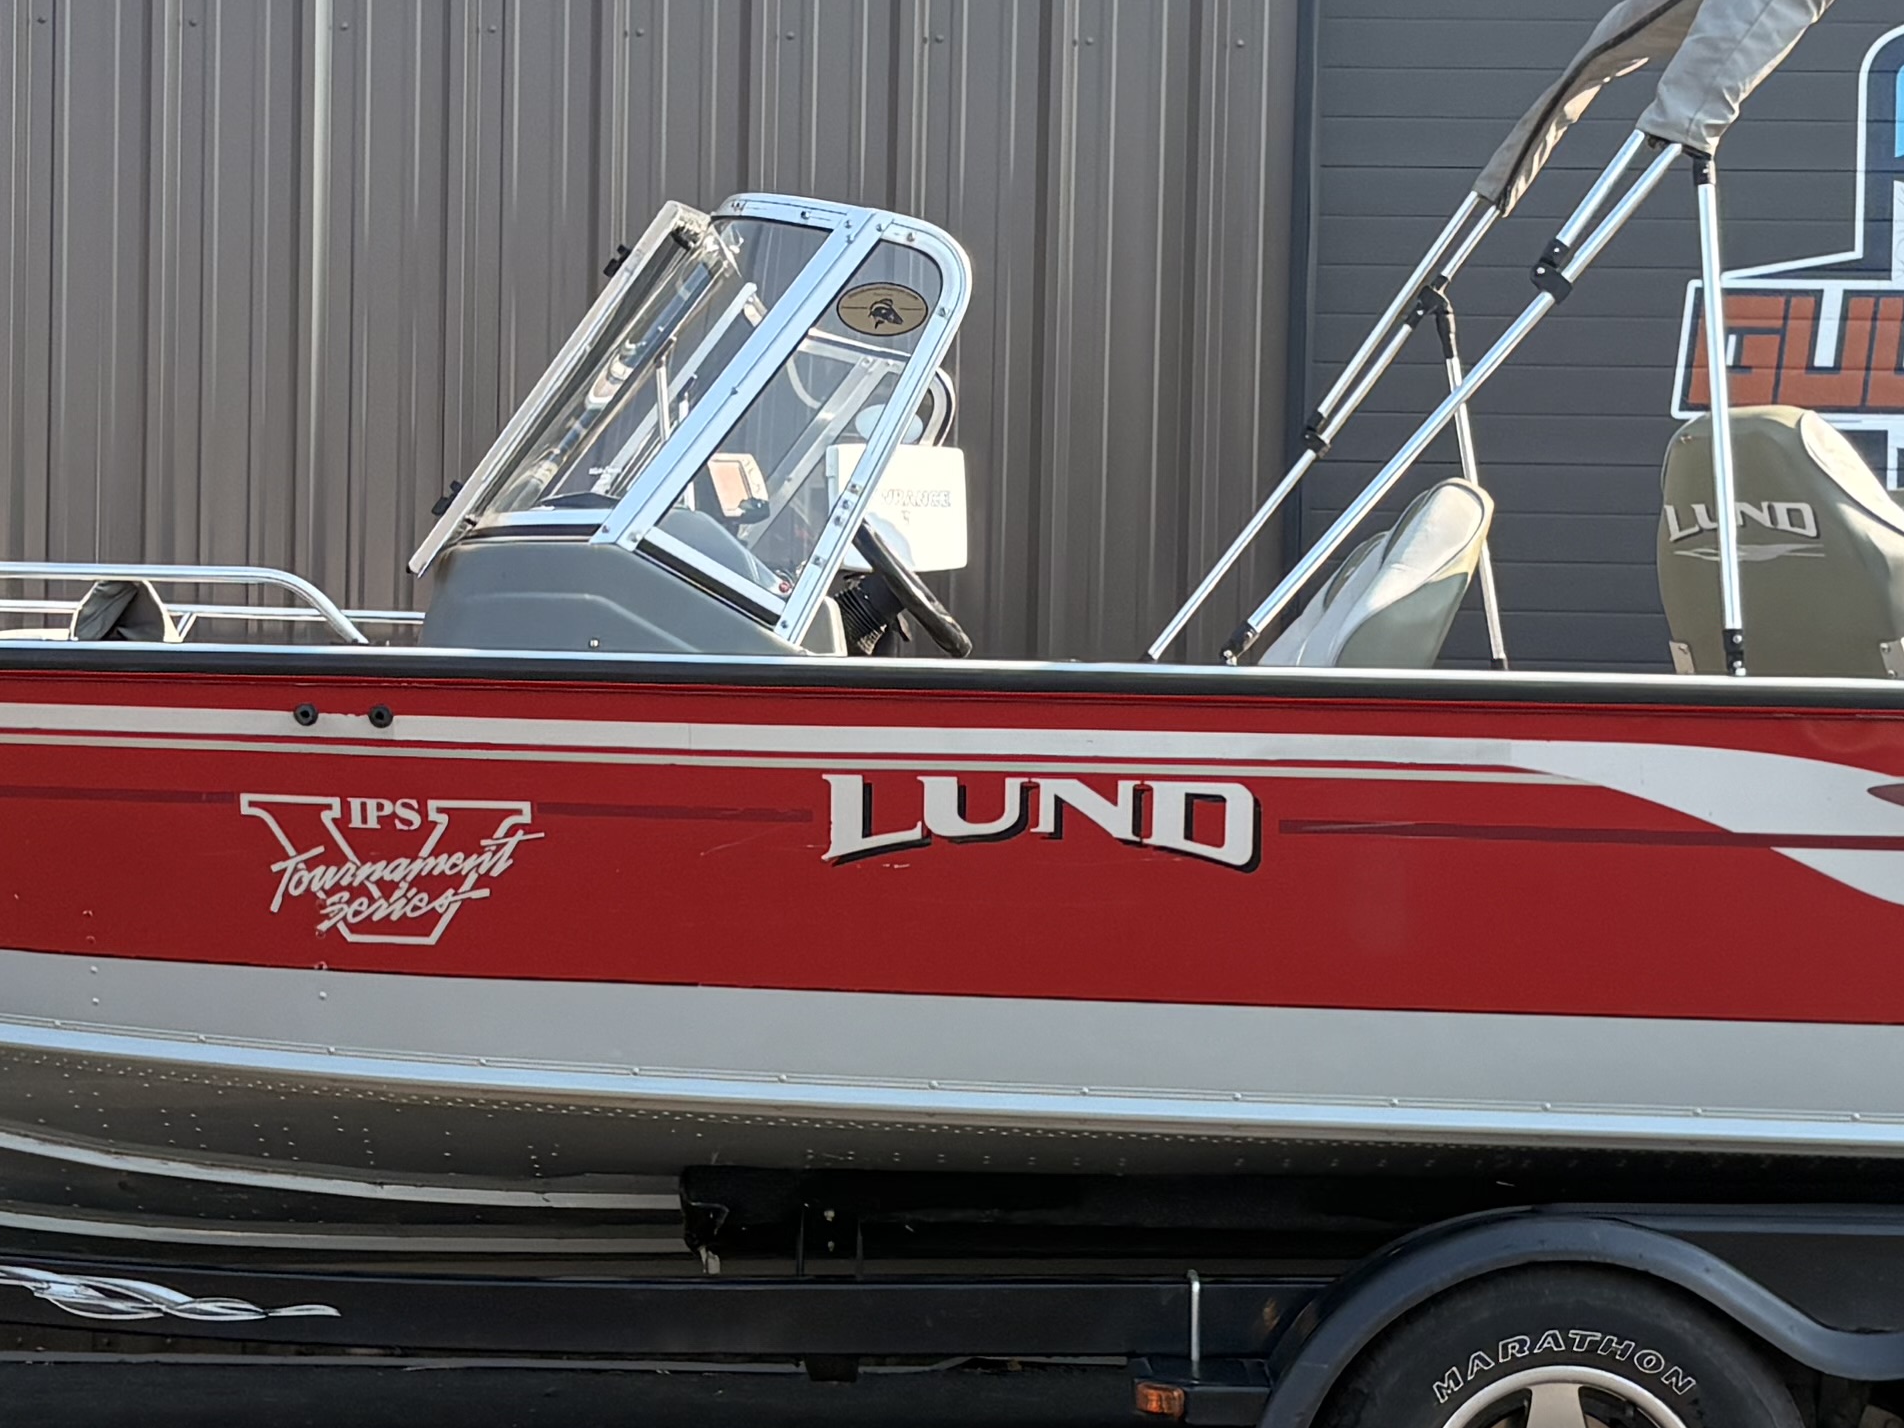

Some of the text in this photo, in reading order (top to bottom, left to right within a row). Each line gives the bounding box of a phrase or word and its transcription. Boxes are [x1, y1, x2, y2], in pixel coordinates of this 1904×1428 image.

[346, 797, 422, 830] IPS
[821, 774, 1262, 873] LUND
[269, 828, 545, 913] Tournament
[315, 887, 491, 933] Series
[1432, 1329, 1696, 1404] MARATHON
